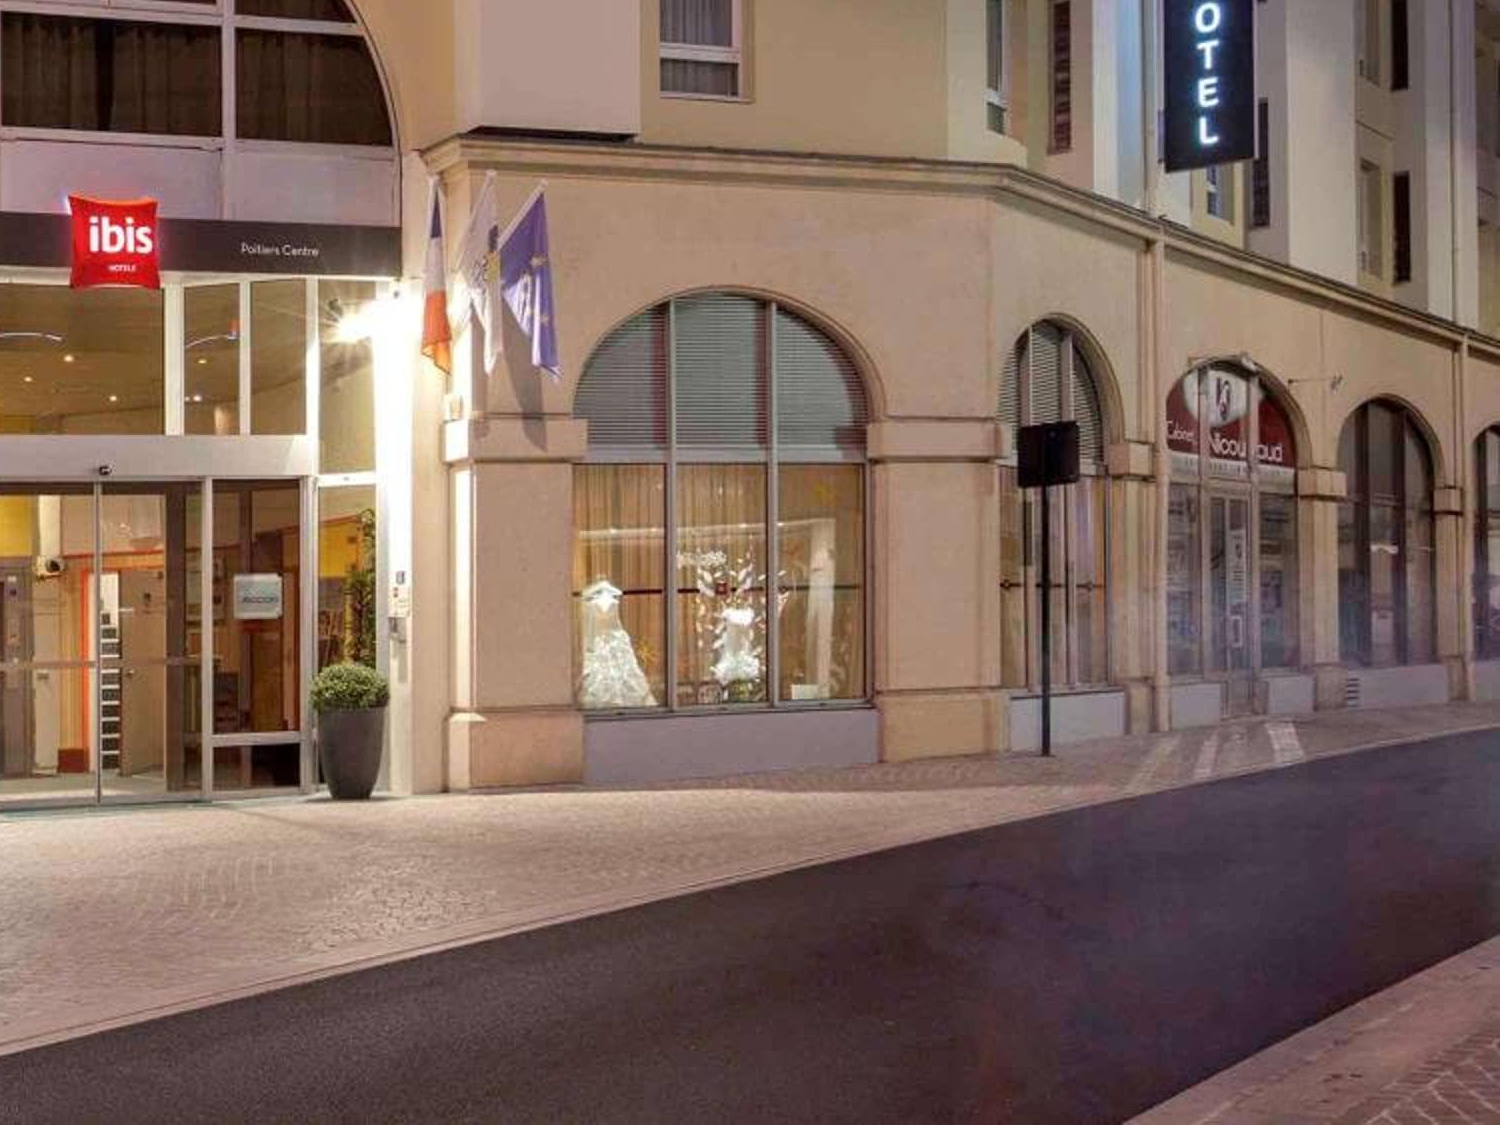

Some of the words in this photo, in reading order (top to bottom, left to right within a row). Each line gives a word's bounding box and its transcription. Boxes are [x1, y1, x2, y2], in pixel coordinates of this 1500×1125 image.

[89, 216, 153, 254] ibis
[241, 241, 280, 255] Poitiers
[282, 244, 319, 257] Centre
